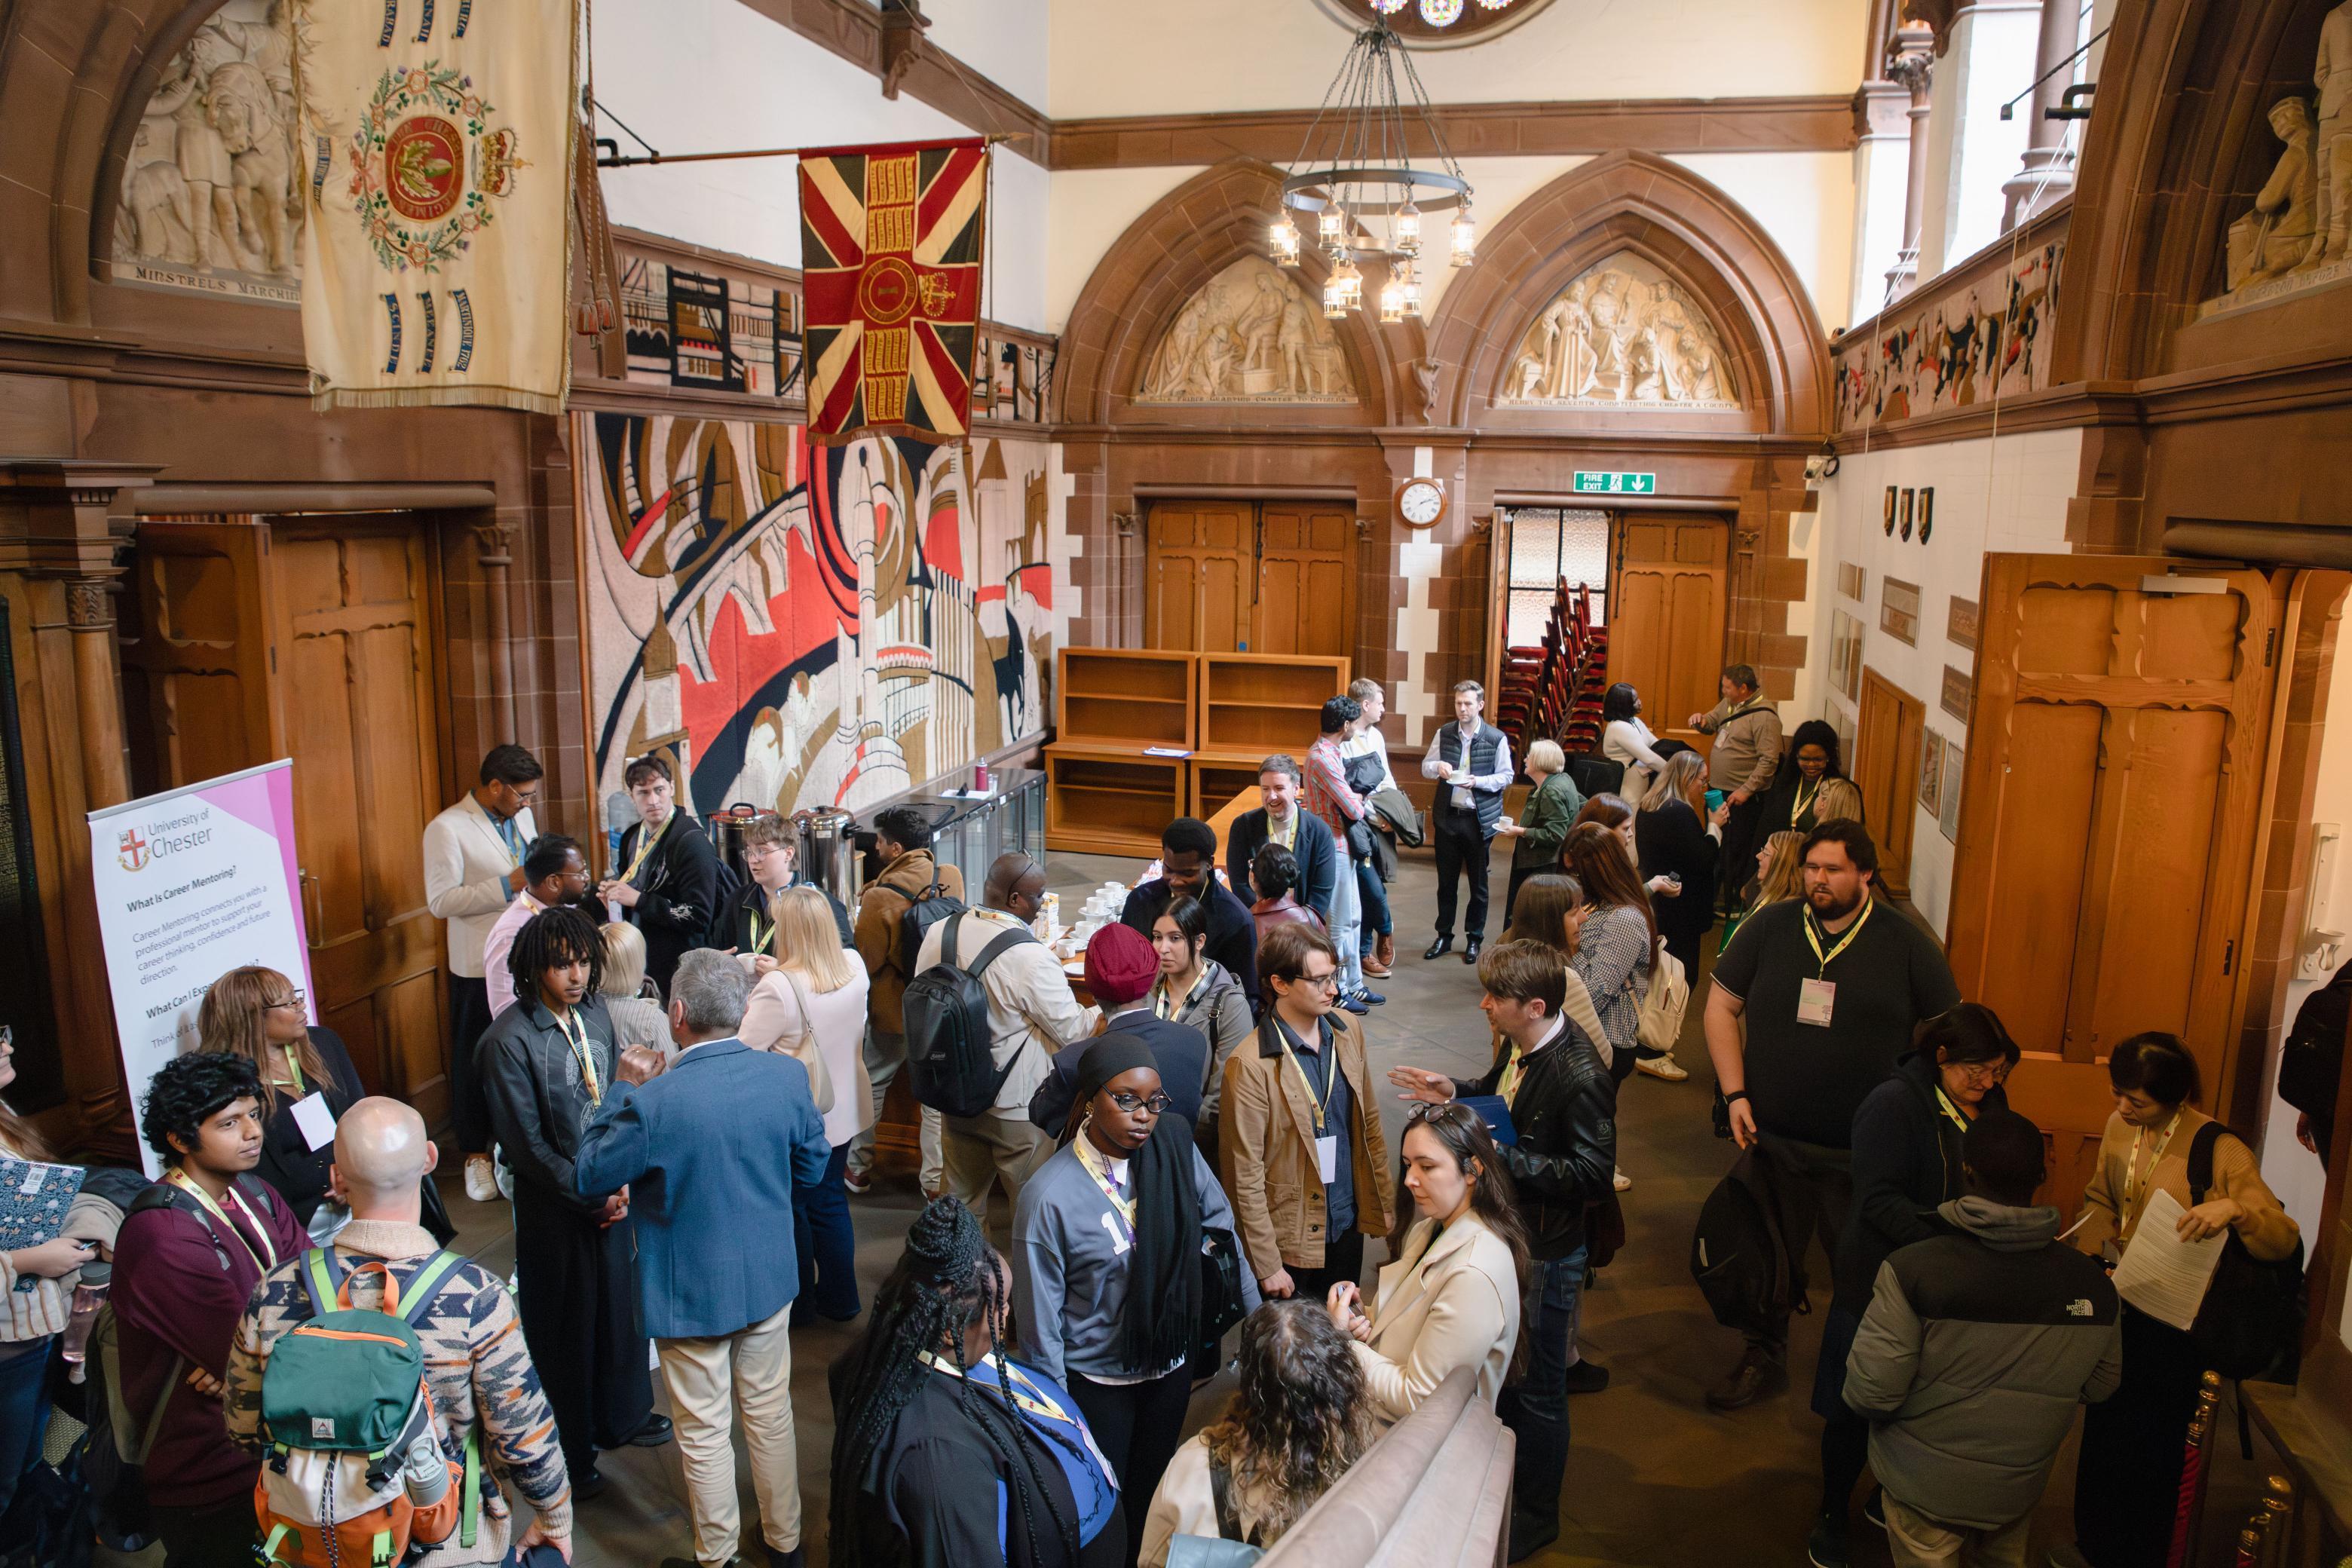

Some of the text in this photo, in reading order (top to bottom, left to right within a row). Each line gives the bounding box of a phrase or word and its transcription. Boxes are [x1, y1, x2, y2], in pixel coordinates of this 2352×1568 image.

[135, 266, 301, 302] MINSTRELS MARCHIN
[1583, 473, 1603, 482] FIRE
[1583, 482, 1603, 490] EXIT
[148, 808, 210, 836] University of
[152, 828, 213, 859] Chester
[127, 865, 237, 913] What Is Career Mentoring?
[132, 926, 161, 944] Career
[161, 910, 200, 933] Mentoring
[201, 899, 234, 917] connects
[234, 894, 246, 907] you
[246, 886, 262, 899] with
[135, 900, 263, 959] professional mentor to support your
[137, 954, 164, 972] career
[197, 923, 237, 947] confidence
[236, 917, 249, 931] and
[248, 909, 271, 926] future
[139, 963, 179, 985] direction.
[145, 1002, 172, 1019] What
[172, 994, 188, 1008] Can
[151, 1032, 175, 1049] Think
[1101, 1210, 1131, 1255] 1
